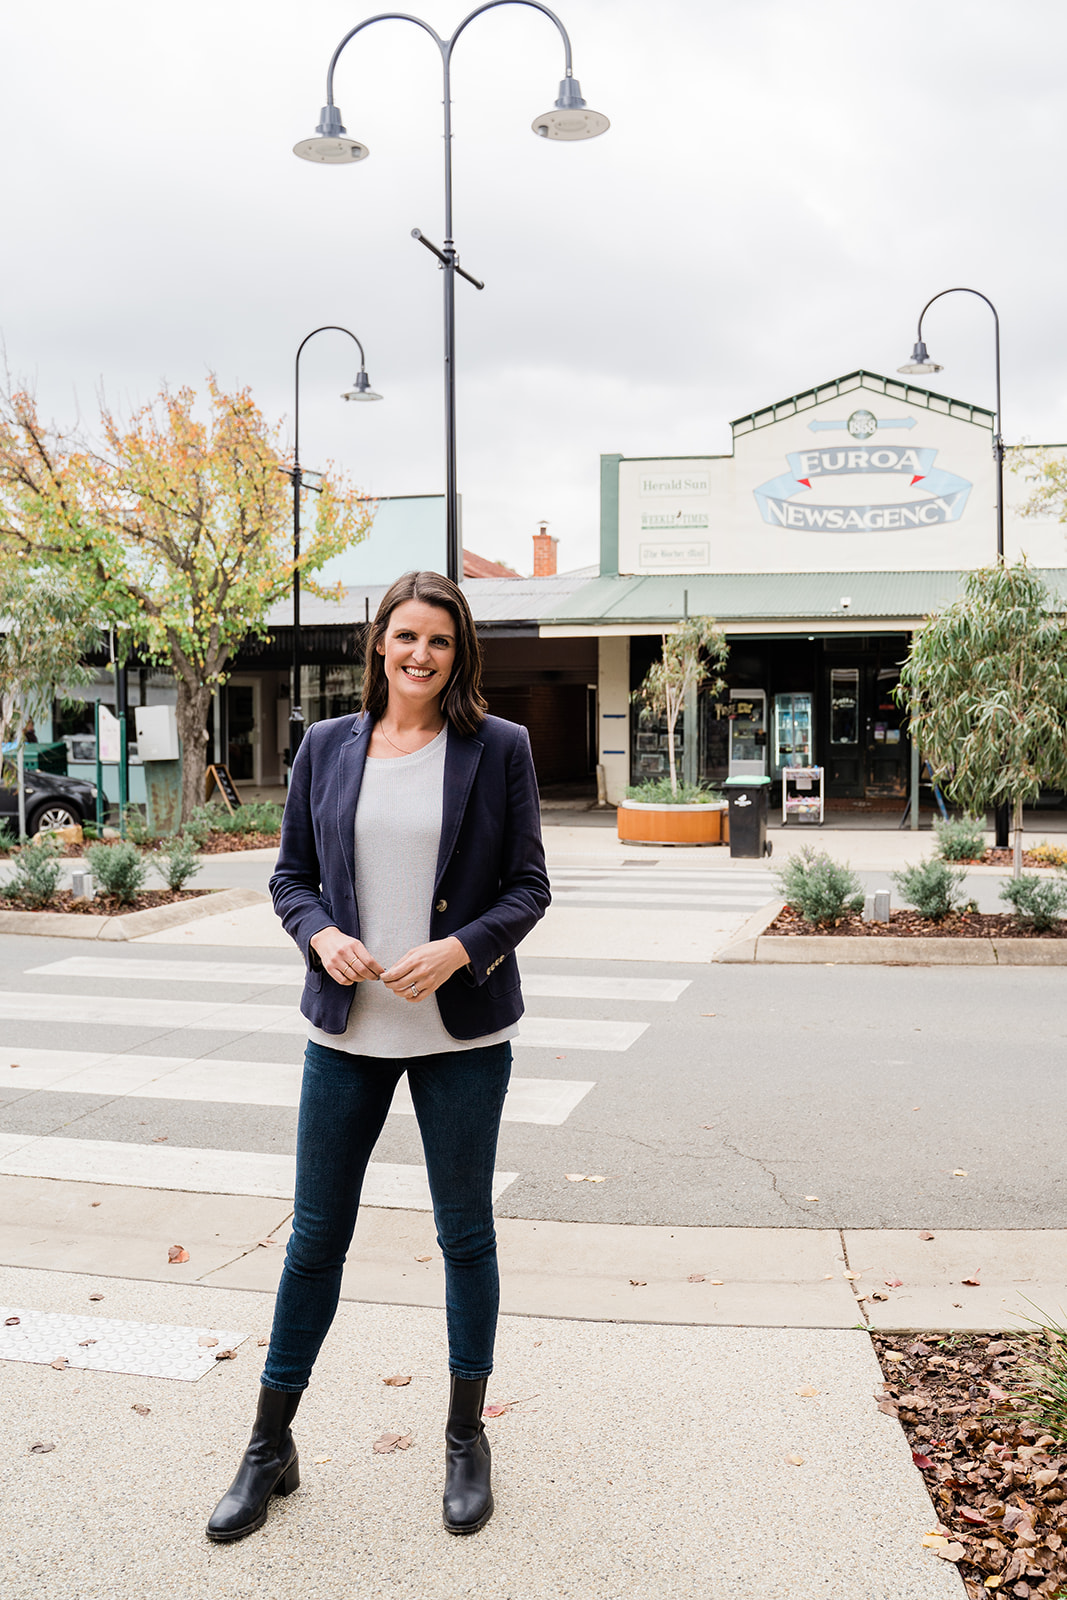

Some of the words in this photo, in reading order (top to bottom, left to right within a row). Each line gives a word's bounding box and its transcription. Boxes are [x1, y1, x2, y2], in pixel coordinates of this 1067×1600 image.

[799, 449, 923, 475] EUROA
[643, 479, 682, 491] Herald
[684, 479, 707, 490] Sun
[766, 493, 963, 530] NEWSAGENCY
